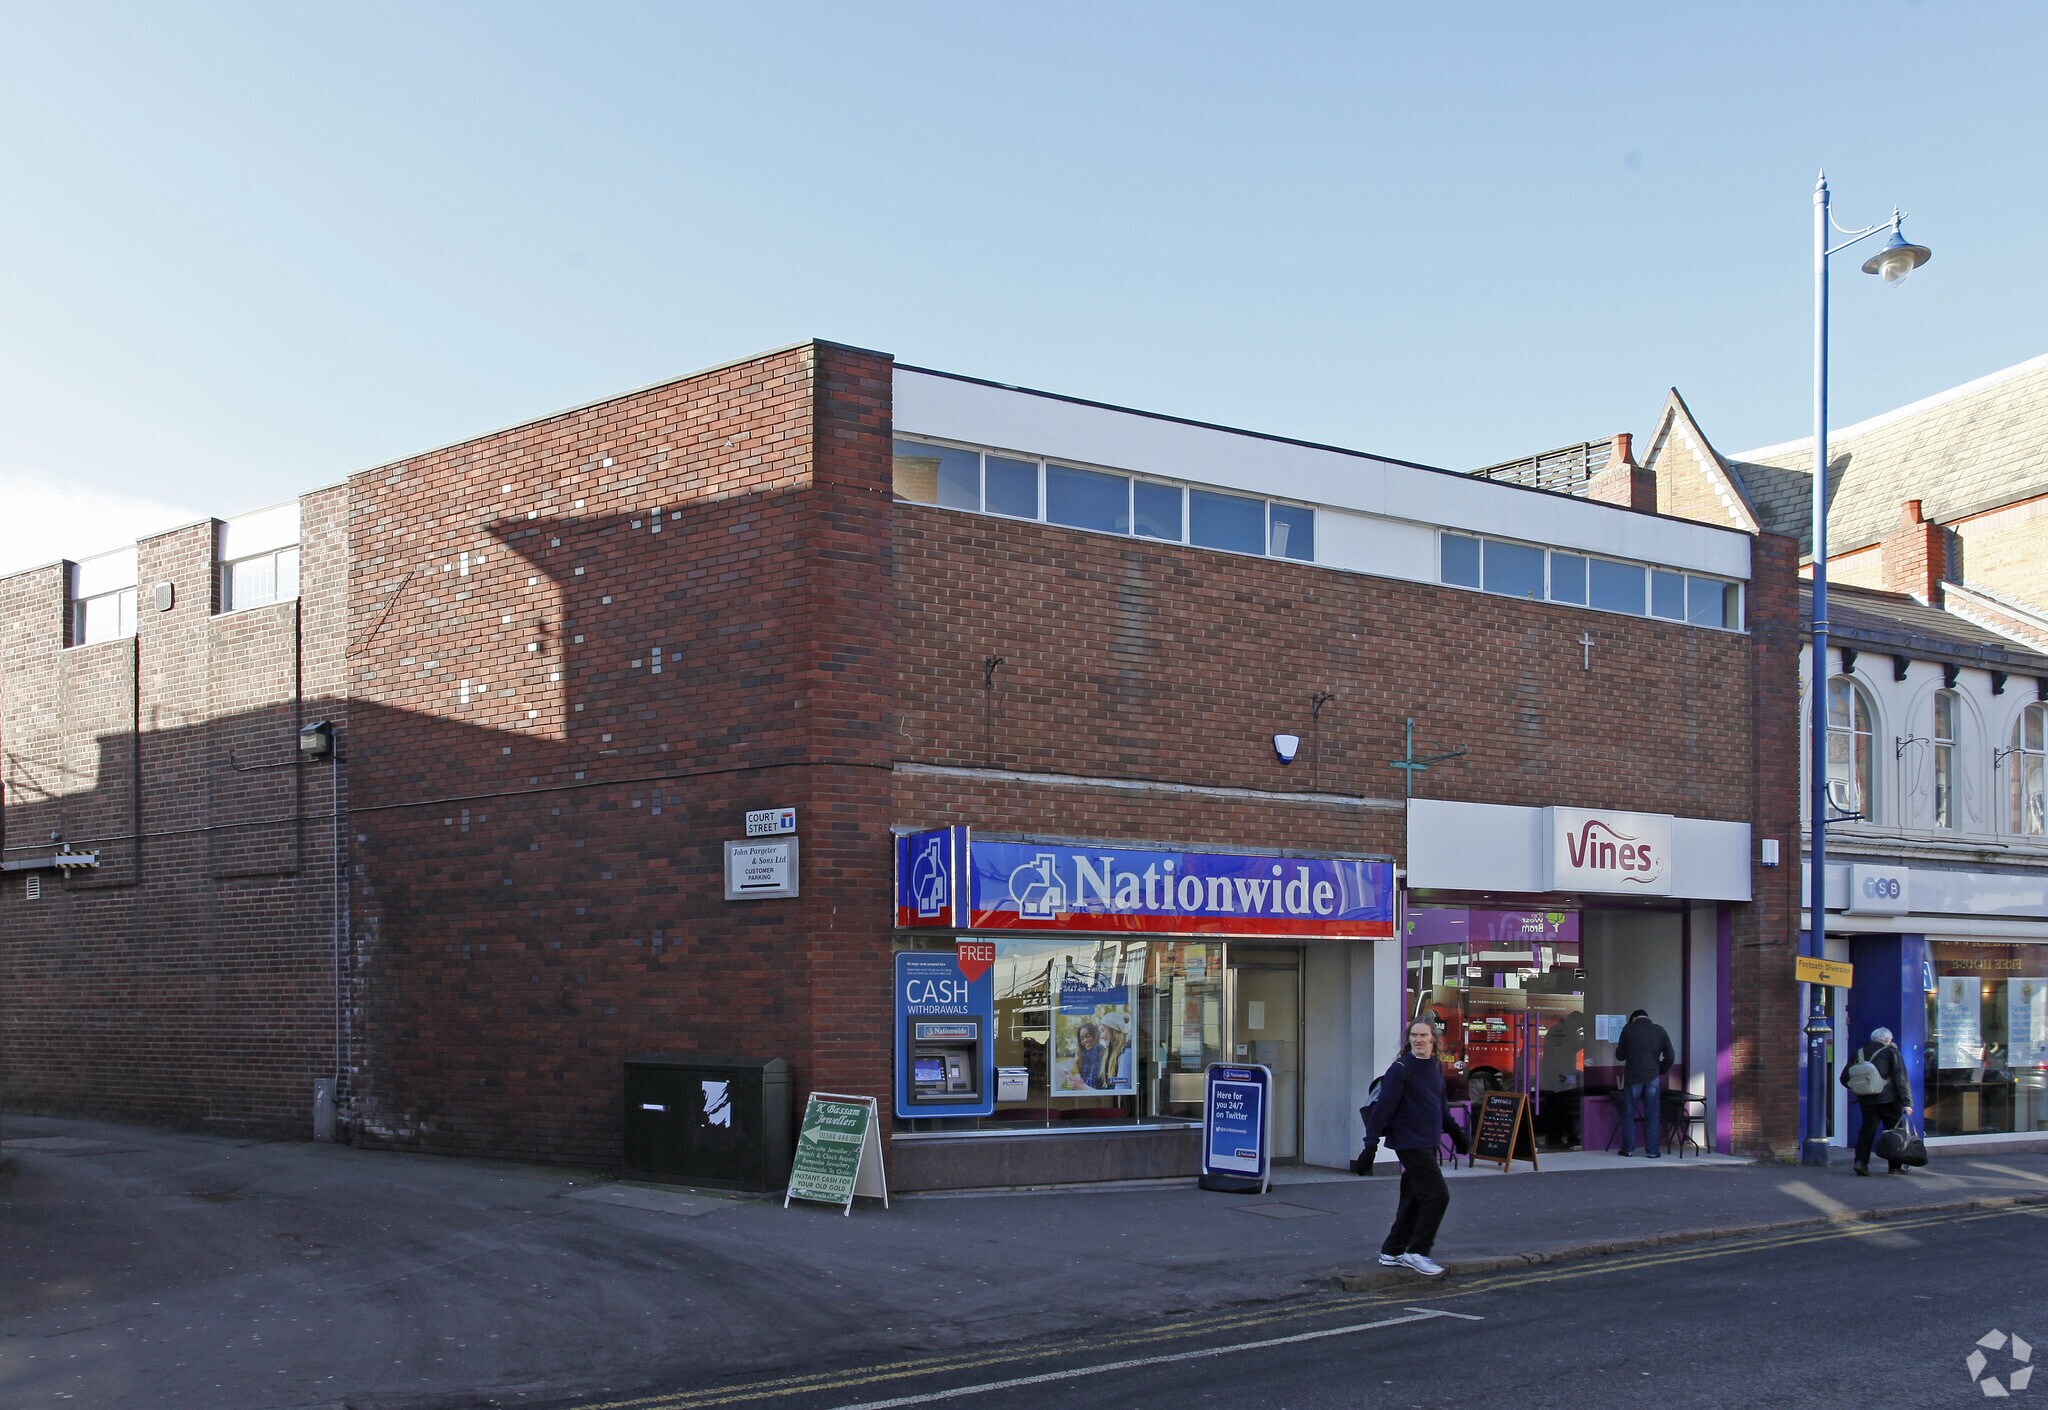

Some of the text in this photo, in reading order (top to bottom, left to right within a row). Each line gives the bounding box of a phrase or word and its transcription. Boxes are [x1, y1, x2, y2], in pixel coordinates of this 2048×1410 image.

[748, 812, 775, 823] COURT
[748, 822, 778, 833] STREET
[1566, 819, 1652, 872] Vines
[733, 847, 777, 856] John Pargeter
[751, 855, 787, 865] & Sons Ltd
[744, 867, 774, 875] CUSTOMER
[747, 873, 772, 881] PARKING
[1072, 854, 1335, 916] Nationwide
[1867, 881, 1899, 896] TSB
[959, 945, 993, 961] FREE
[1798, 959, 1851, 974] Footpath Diversion
[905, 979, 969, 1004] CASH
[907, 1005, 969, 1014] WITHDRAWALS
[934, 1027, 967, 1035] Nationwide
[1216, 1091, 1243, 1101] Here for
[816, 1103, 861, 1116] K Bassam
[1216, 1101, 1244, 1111] you 24/7
[815, 1114, 857, 1127] Jewellers
[1225, 1110, 1248, 1121] Twitter
[799, 1150, 817, 1158] Watch
[823, 1152, 837, 1160] Clock
[802, 1157, 851, 1170] Bespoke Jewellery
[798, 1164, 828, 1174] Handmade
[836, 1167, 853, 1176] Order
[795, 1172, 851, 1185] INSTANT CASH FOR
[798, 1180, 846, 1192] YOUR OLD GOLD
